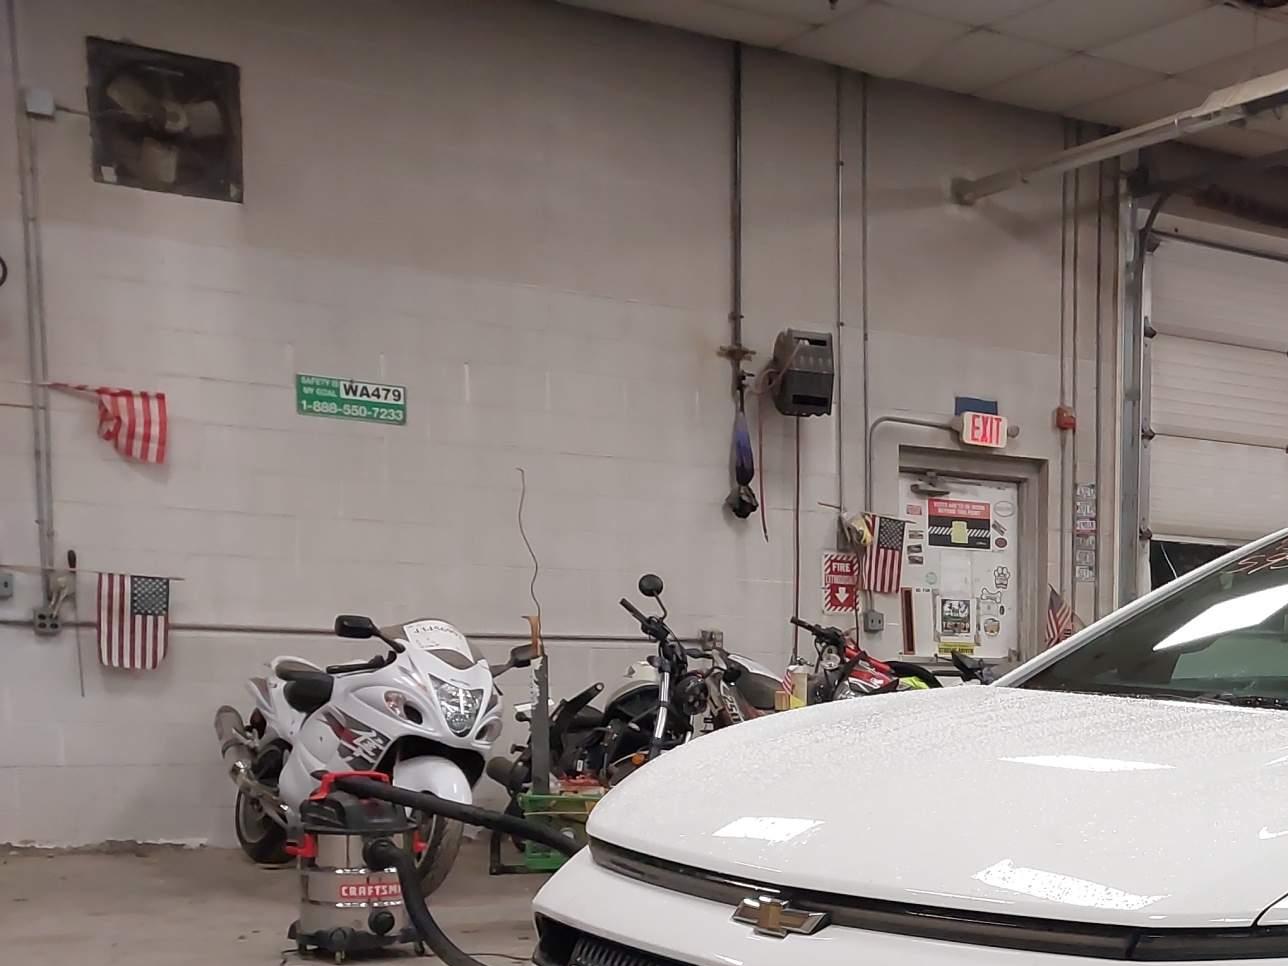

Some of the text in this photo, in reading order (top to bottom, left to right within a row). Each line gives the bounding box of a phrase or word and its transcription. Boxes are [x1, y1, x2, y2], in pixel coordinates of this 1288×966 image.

[343, 384, 402, 402] WA479
[302, 400, 403, 421] 1-888-550-7233
[971, 414, 1002, 446] EXIT
[832, 562, 851, 573] FIRE
[341, 885, 400, 896] CRAFTSM
